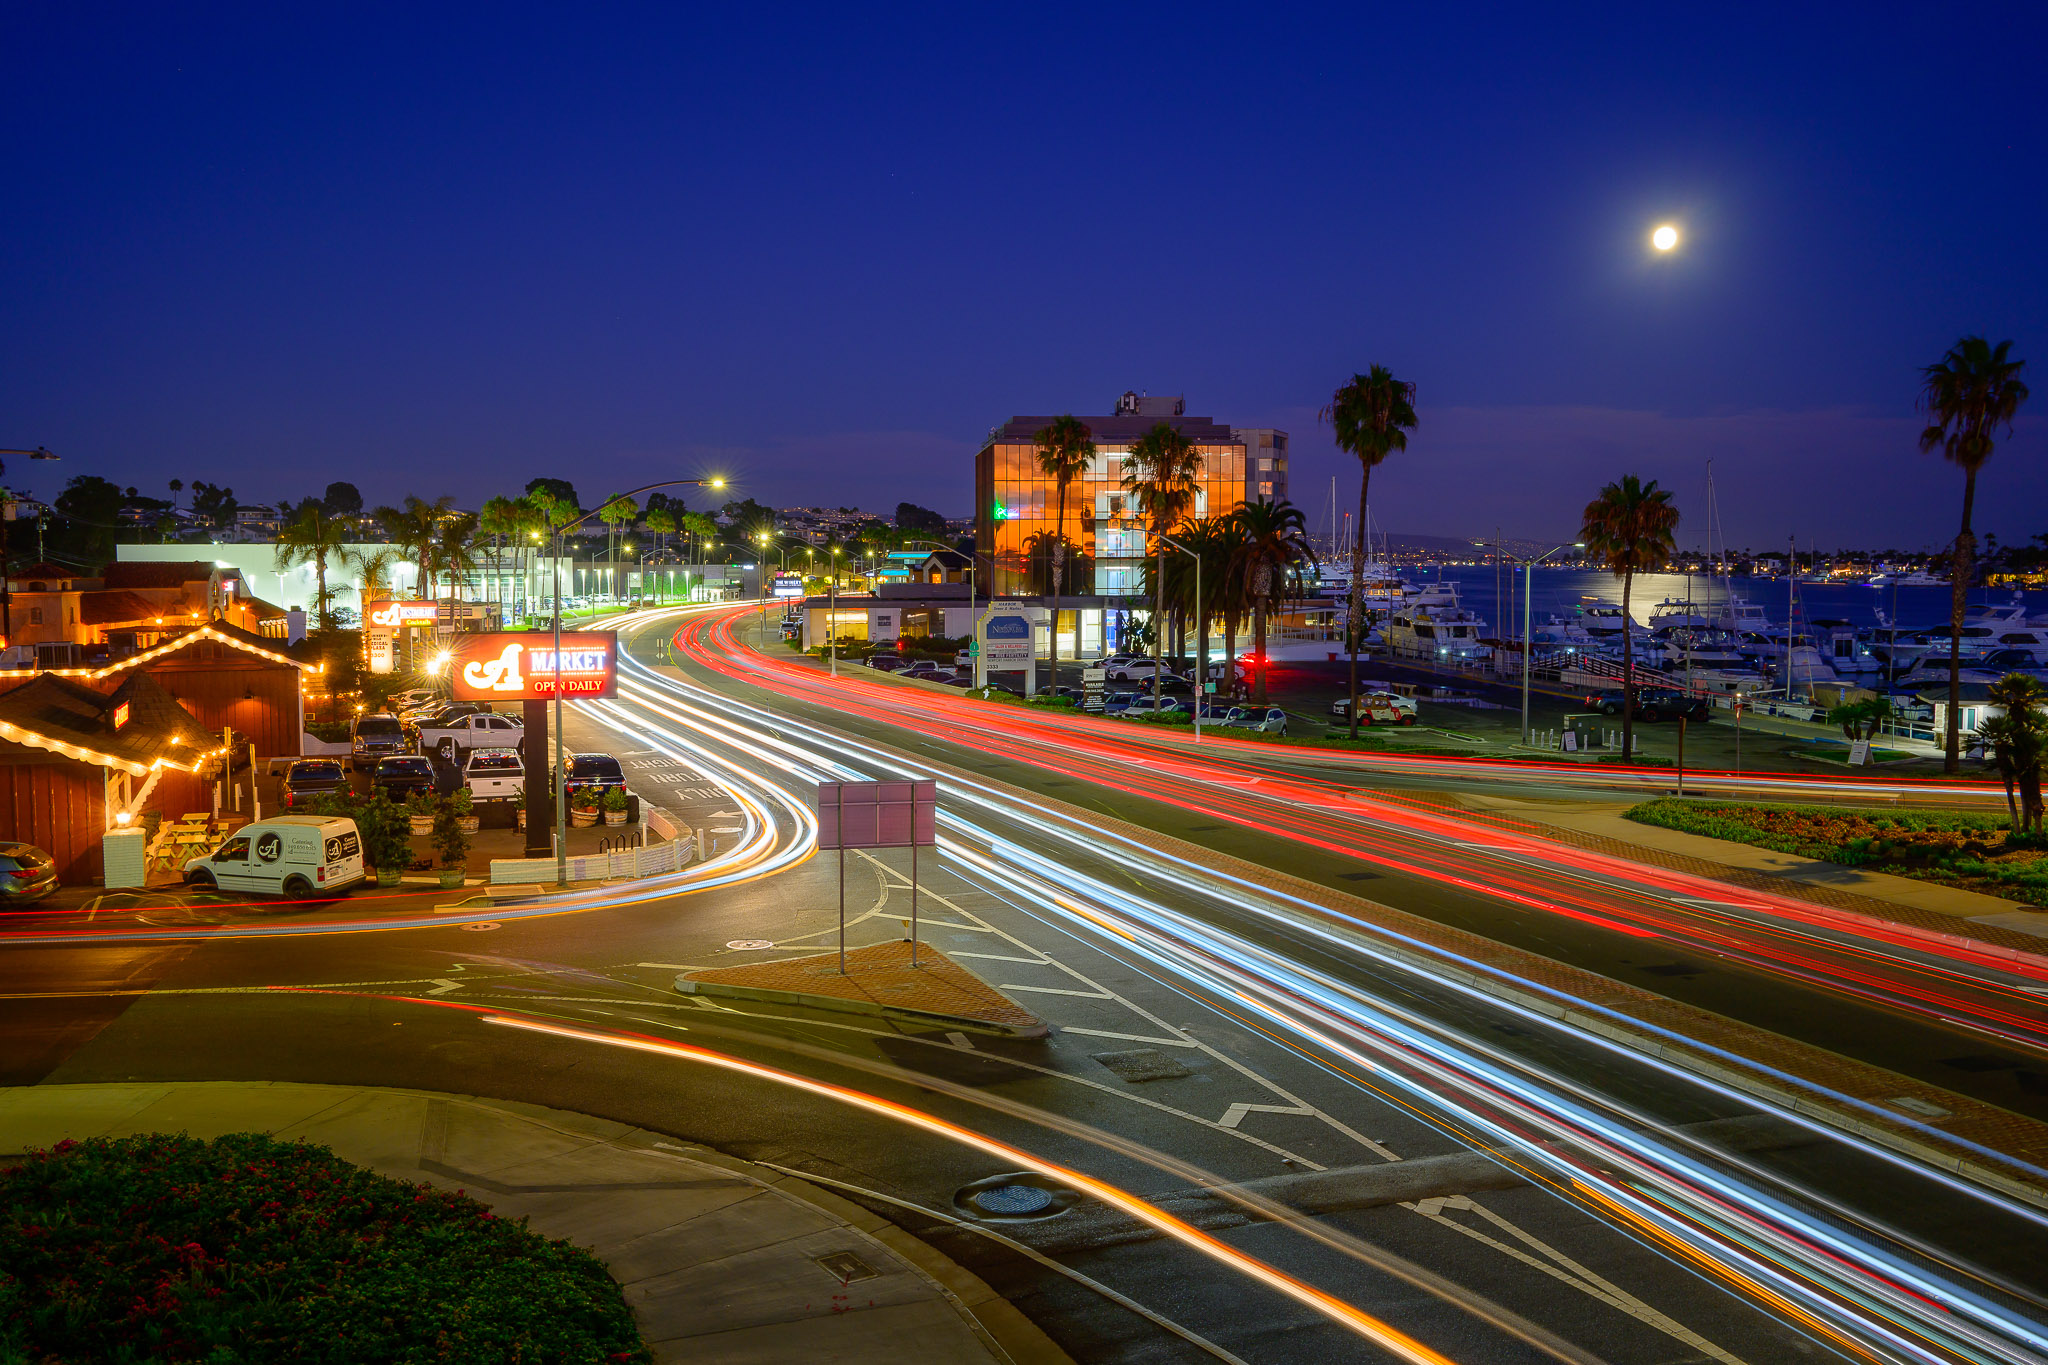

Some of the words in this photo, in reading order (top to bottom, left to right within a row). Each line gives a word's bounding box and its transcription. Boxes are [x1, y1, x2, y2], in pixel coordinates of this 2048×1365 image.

[531, 651, 606, 671] MARKET
[534, 681, 566, 691] OPEN
[569, 680, 602, 691] DAILY
[650, 773, 708, 783] TURN
[292, 838, 313, 846] Catering
